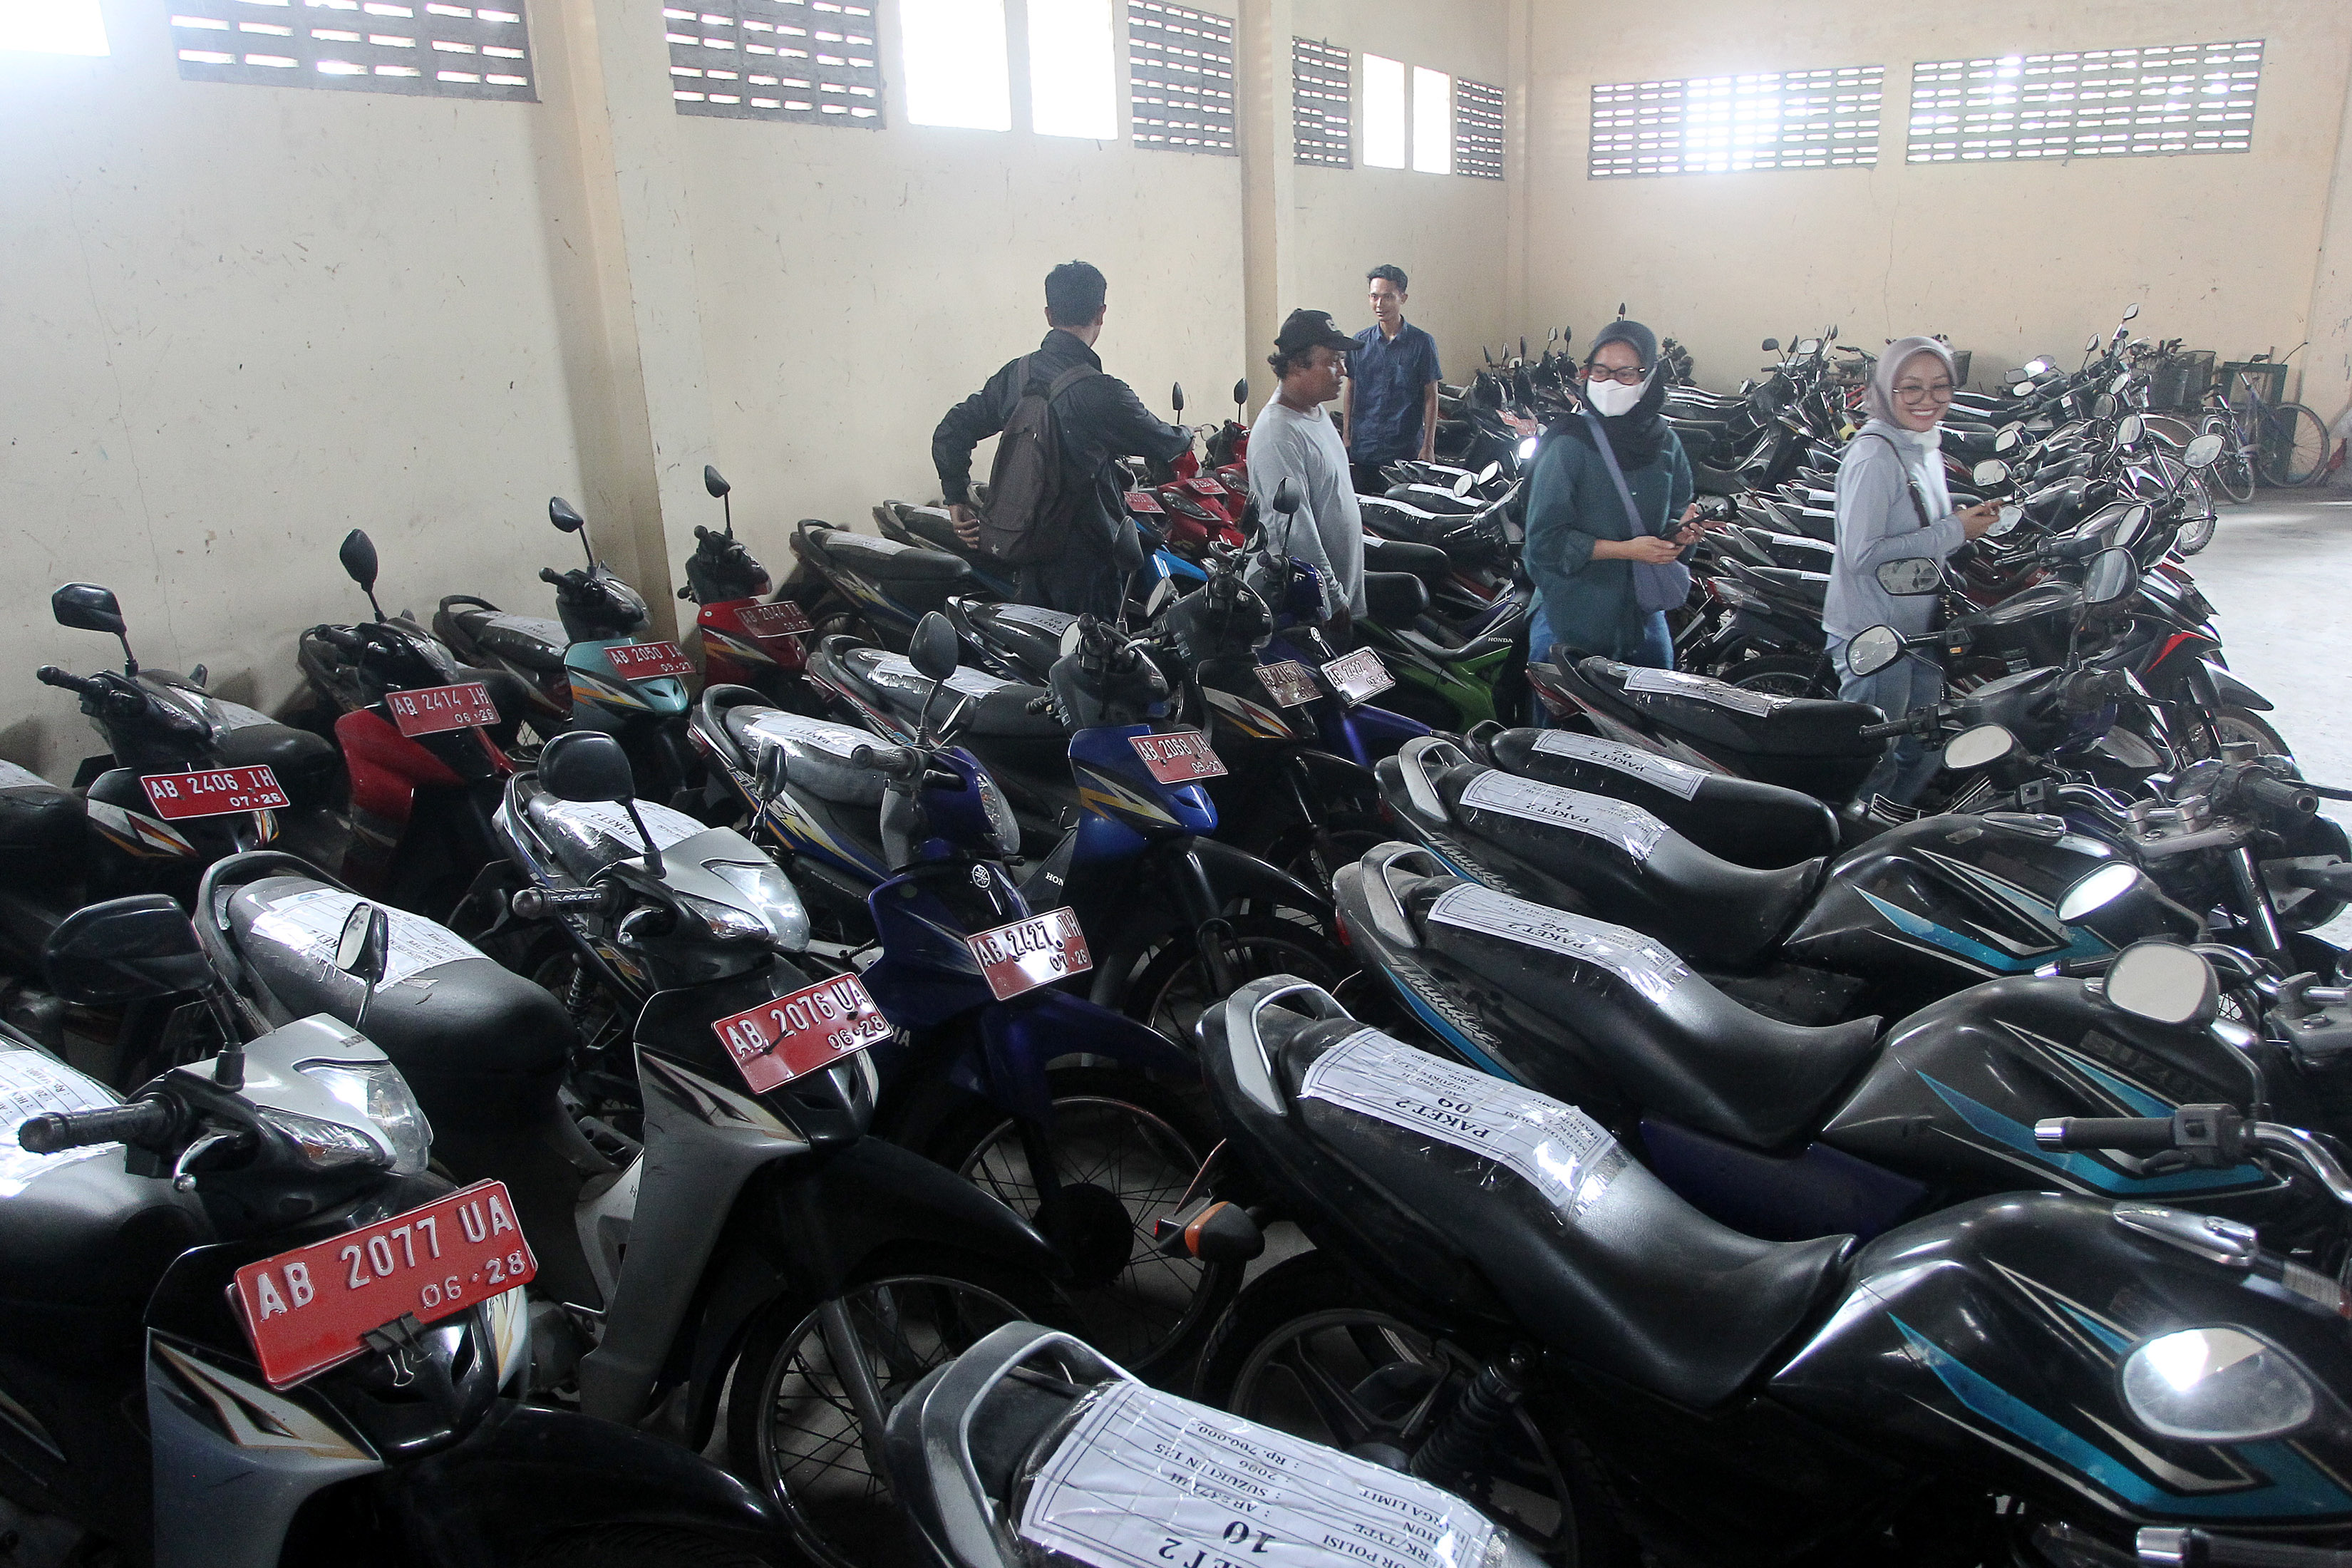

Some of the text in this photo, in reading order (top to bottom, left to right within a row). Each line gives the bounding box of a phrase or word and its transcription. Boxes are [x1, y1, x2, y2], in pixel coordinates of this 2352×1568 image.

[610, 645, 684, 664] AB 2050 IA
[1329, 669, 1346, 688] AB
[1342, 660, 1367, 681] 2422
[394, 687, 490, 715] AB 2414 IH
[1137, 741, 1159, 760] AB
[1158, 738, 1192, 758] 2068
[1613, 749, 1632, 758] 02
[1599, 754, 1644, 772] PAKET
[150, 769, 274, 799] AB 2406 IH
[1537, 807, 1590, 823] PAKET
[1554, 801, 1574, 810] 11
[599, 817, 636, 835] PAKET
[1046, 872, 1064, 887] HON
[976, 912, 1081, 967] AB 2427 IH
[1522, 929, 1586, 949] PAKET
[726, 979, 867, 1056] AB 2076 UA
[1438, 1098, 1472, 1113] 09
[1396, 1100, 1490, 1138] PAKET 2
[1544, 1127, 1581, 1158] NOMOR
[257, 1195, 512, 1321] AB 2077 UA
[1155, 1443, 1182, 1459] 125
[1264, 1450, 1286, 1465] Rp.
[1239, 1460, 1276, 1480] 2006
[1210, 1468, 1269, 1497] SUZUKI
[1359, 1490, 1408, 1511] LIMIT
[1158, 1537, 1182, 1559] 2
[1223, 1521, 1276, 1553] 10
[1353, 1523, 1443, 1568] ERK/TYPE
[1403, 1522, 1458, 1562] THUN
[1324, 1535, 1378, 1563] POLISI
